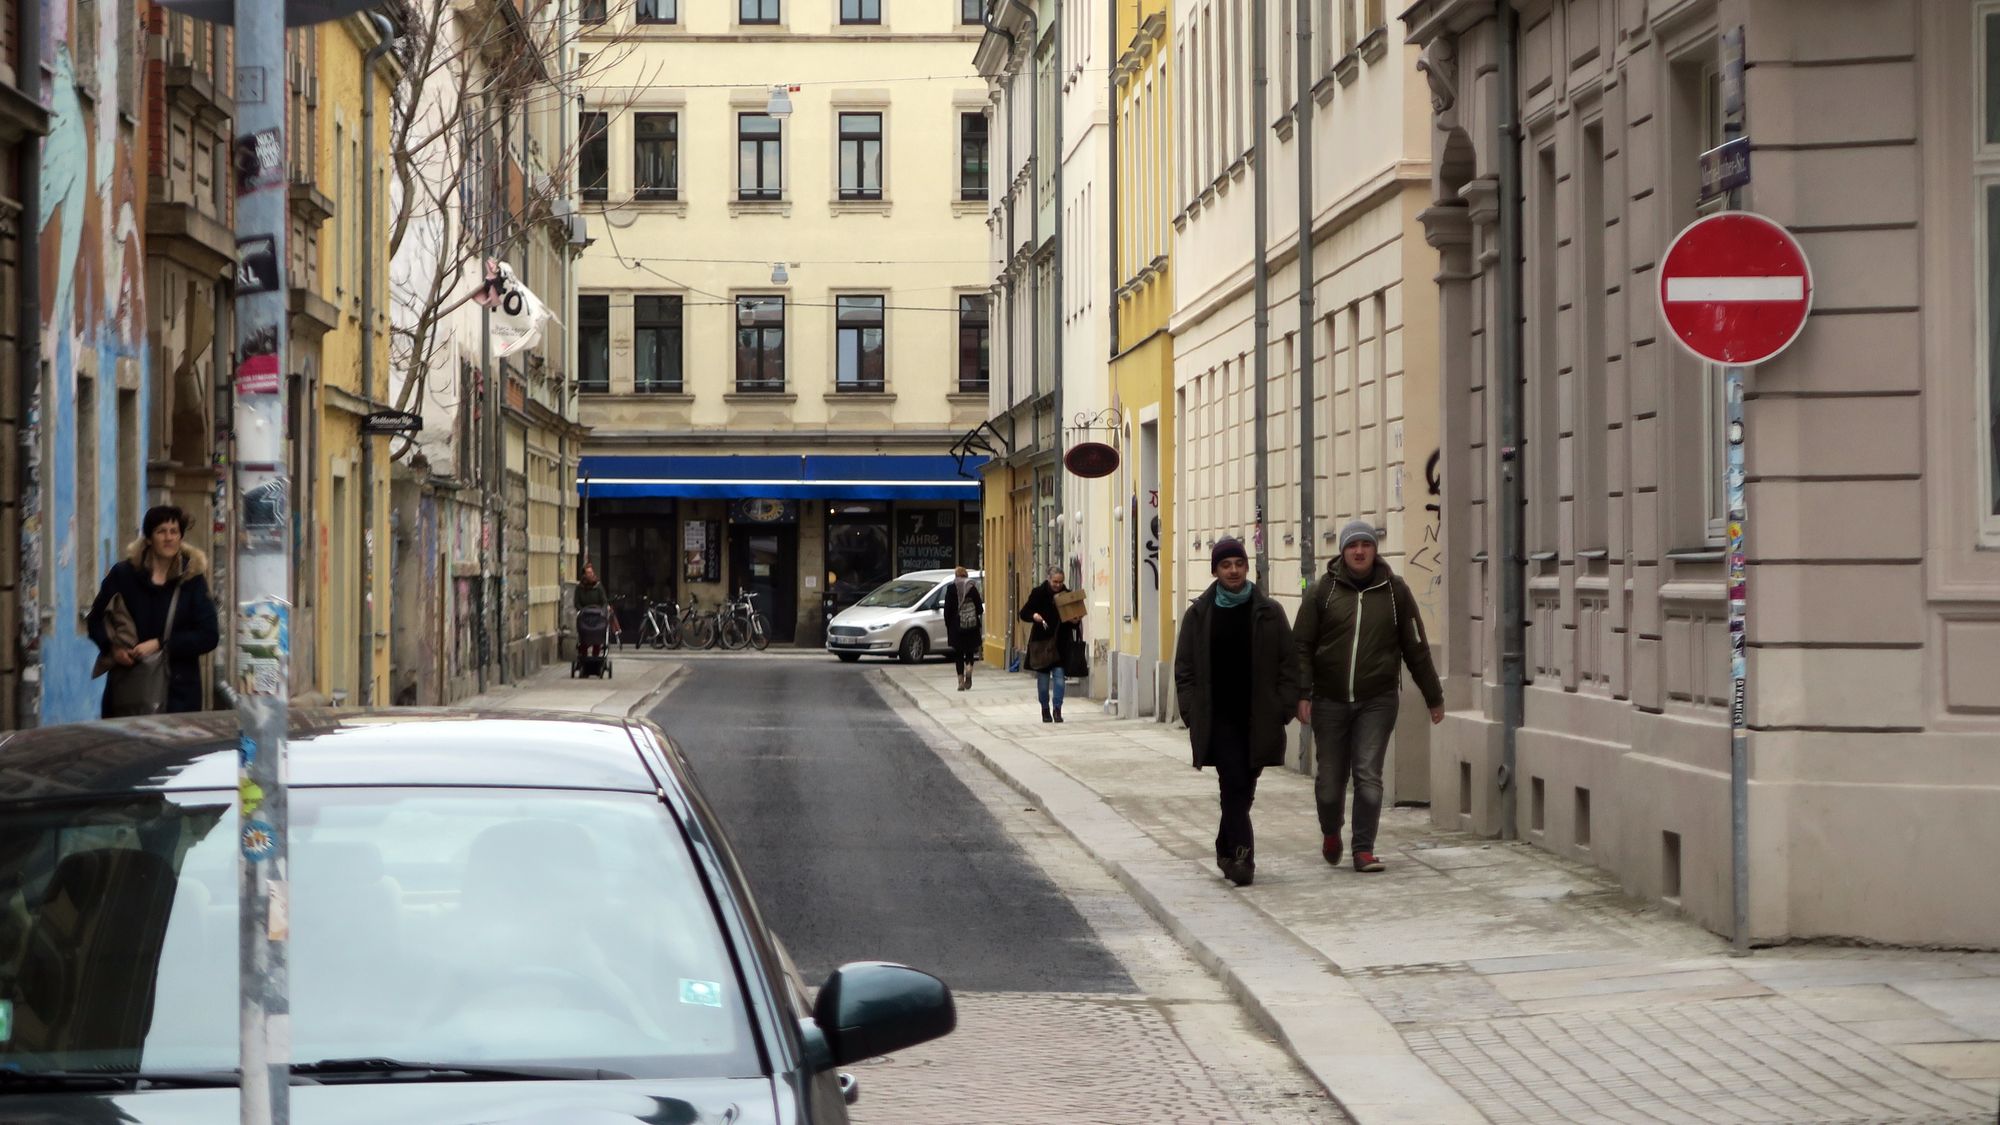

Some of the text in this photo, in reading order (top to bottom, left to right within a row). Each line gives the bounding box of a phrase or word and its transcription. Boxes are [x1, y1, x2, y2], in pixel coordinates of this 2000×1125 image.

[911, 515, 924, 533] 7
[898, 546, 916, 558] BON
[1734, 680, 1746, 724] DYNAMICS
